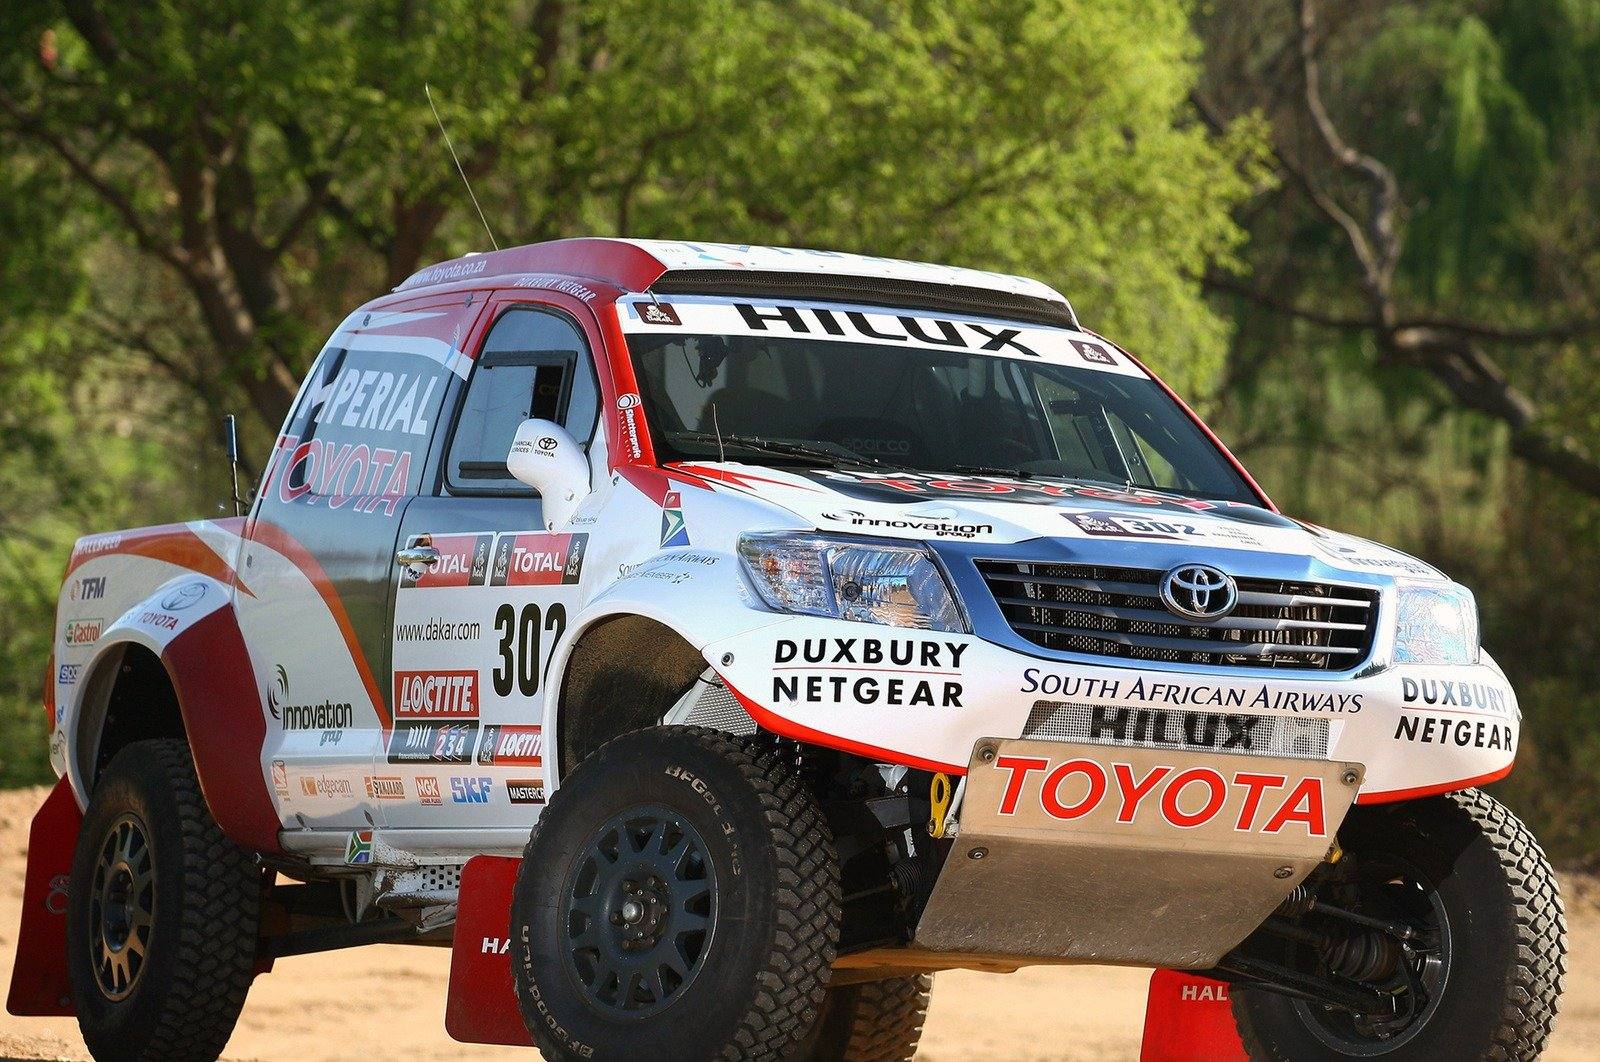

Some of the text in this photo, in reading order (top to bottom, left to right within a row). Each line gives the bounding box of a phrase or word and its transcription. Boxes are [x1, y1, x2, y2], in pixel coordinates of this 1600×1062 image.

[734, 302, 1043, 357] HILUX
[534, 448, 555, 458] TOYOTA
[260, 434, 412, 518] TOYOTA
[851, 512, 993, 535] innovation
[935, 530, 976, 539] group
[1122, 519, 1206, 537] 302
[425, 553, 470, 575] OTAL
[512, 546, 563, 574] TOTAL
[81, 576, 107, 600] TFM
[74, 622, 101, 643] Castrol
[139, 611, 179, 631] TOYOTA
[395, 617, 480, 642] www.dakar.com
[773, 638, 970, 669] DUXBURY
[399, 675, 474, 714] LOCTITE
[772, 676, 965, 708] NETGEAR
[1020, 668, 1364, 714] SOUTH AFRICAN AIRWAYS
[1401, 677, 1508, 713] DUXBURY
[282, 699, 353, 730] innovation
[1088, 704, 1257, 751] HILUX
[319, 729, 343, 747] group
[497, 732, 542, 757] LOCTIT
[1393, 715, 1513, 753] NETGEAR
[316, 774, 353, 799] edgecam
[415, 777, 440, 797] NGK
[449, 776, 493, 804] SKF
[993, 754, 1328, 838] TOYOTA
